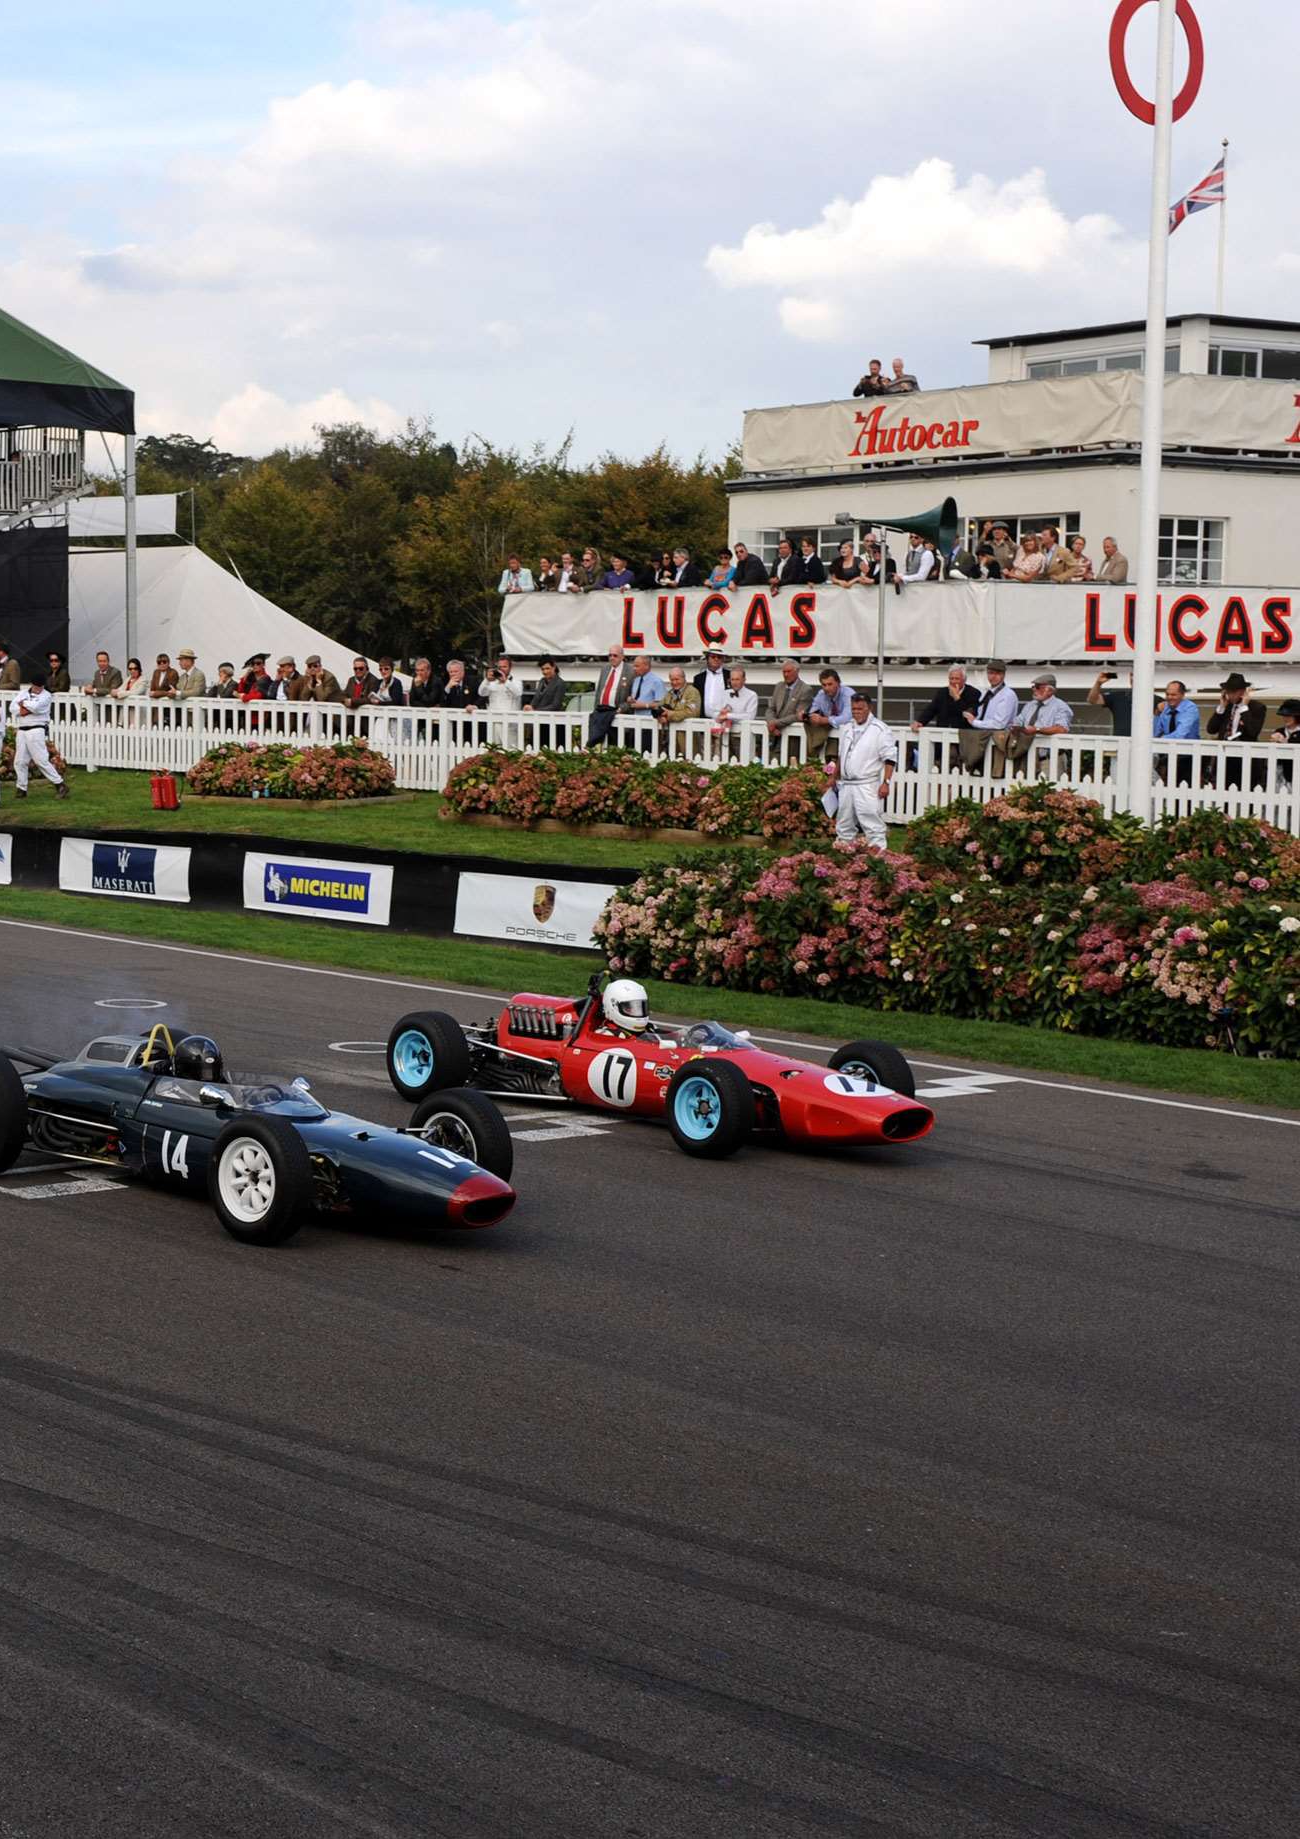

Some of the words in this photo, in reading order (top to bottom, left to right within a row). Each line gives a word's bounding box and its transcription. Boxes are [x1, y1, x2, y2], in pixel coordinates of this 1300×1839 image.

[848, 405, 979, 456] Autocar
[622, 593, 817, 649] LUCAS
[94, 876, 154, 894] MASERATI
[290, 877, 366, 902] MICHELIN
[505, 926, 578, 942] PORSCHE
[602, 1054, 633, 1100] 17
[161, 1129, 189, 1180] 14
